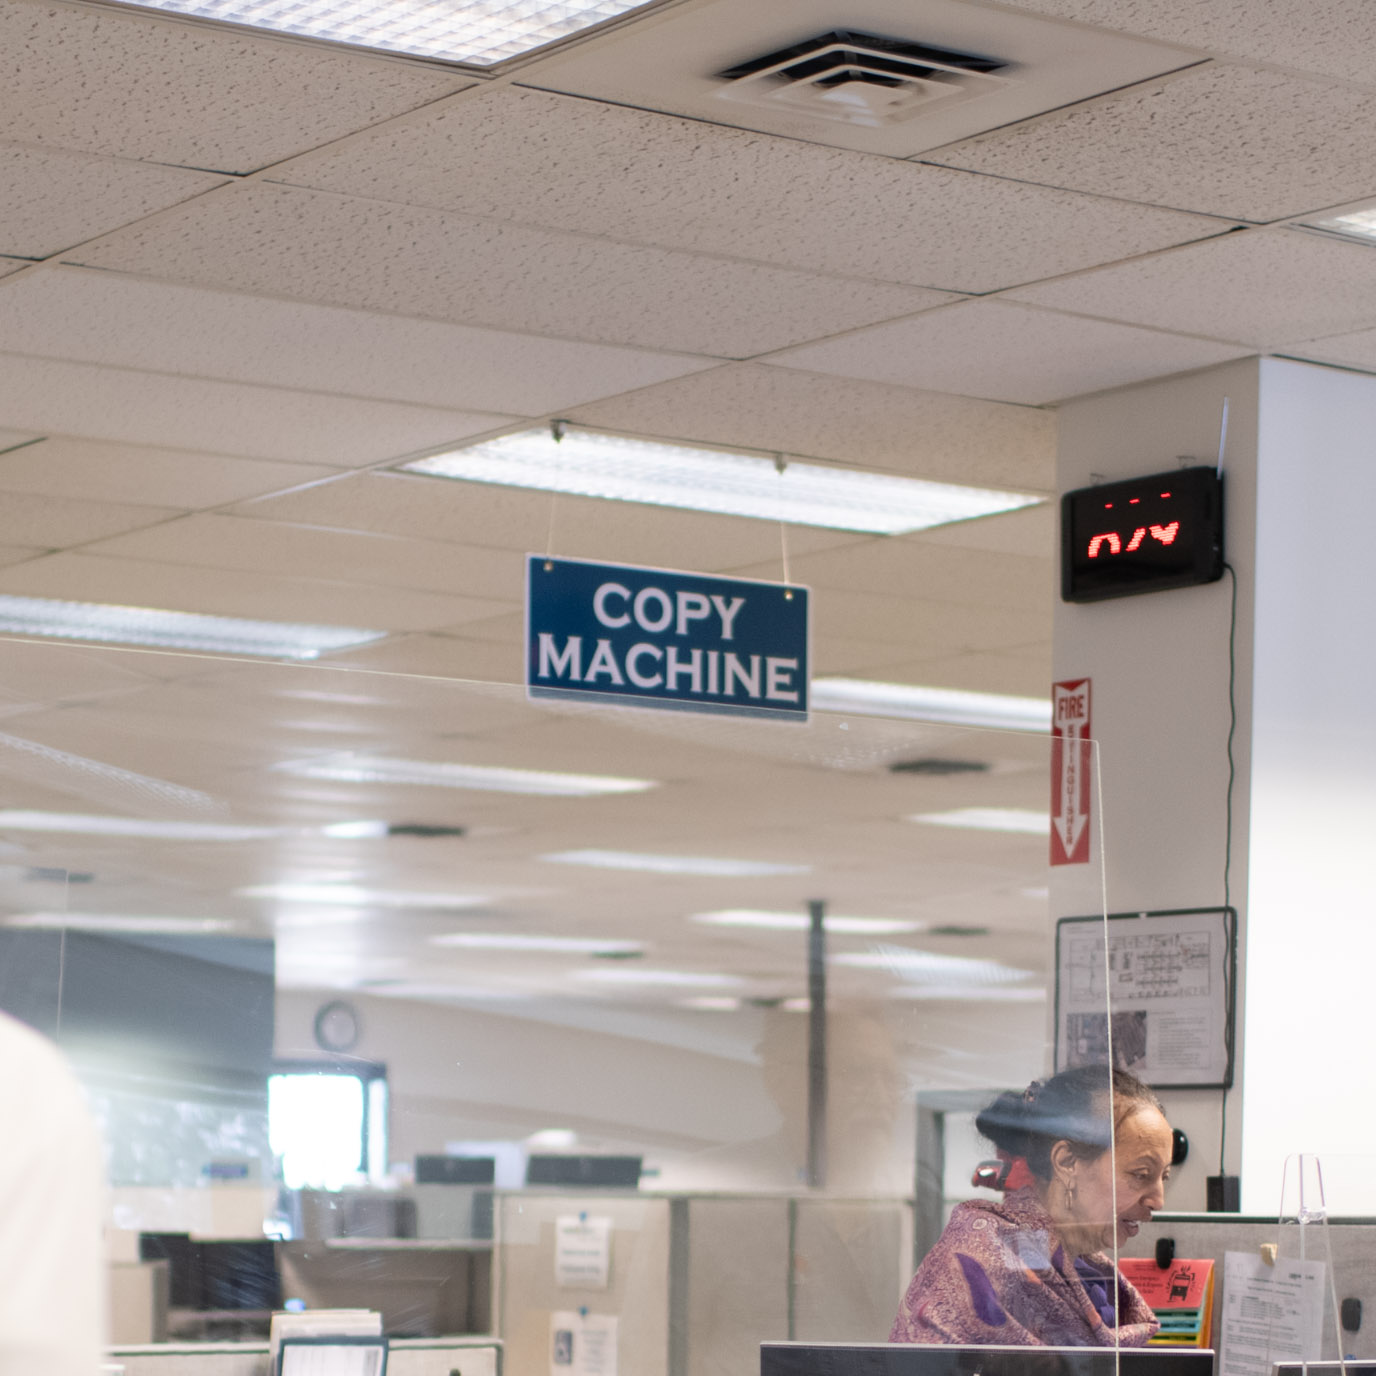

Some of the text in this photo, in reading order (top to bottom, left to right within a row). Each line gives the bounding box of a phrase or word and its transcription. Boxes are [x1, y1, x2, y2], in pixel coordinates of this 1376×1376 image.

[593, 582, 745, 640] COPY
[537, 633, 799, 702] MACHINE
[1058, 694, 1084, 720] FIRE
[1066, 724, 1076, 844] EXTINGUISHER
